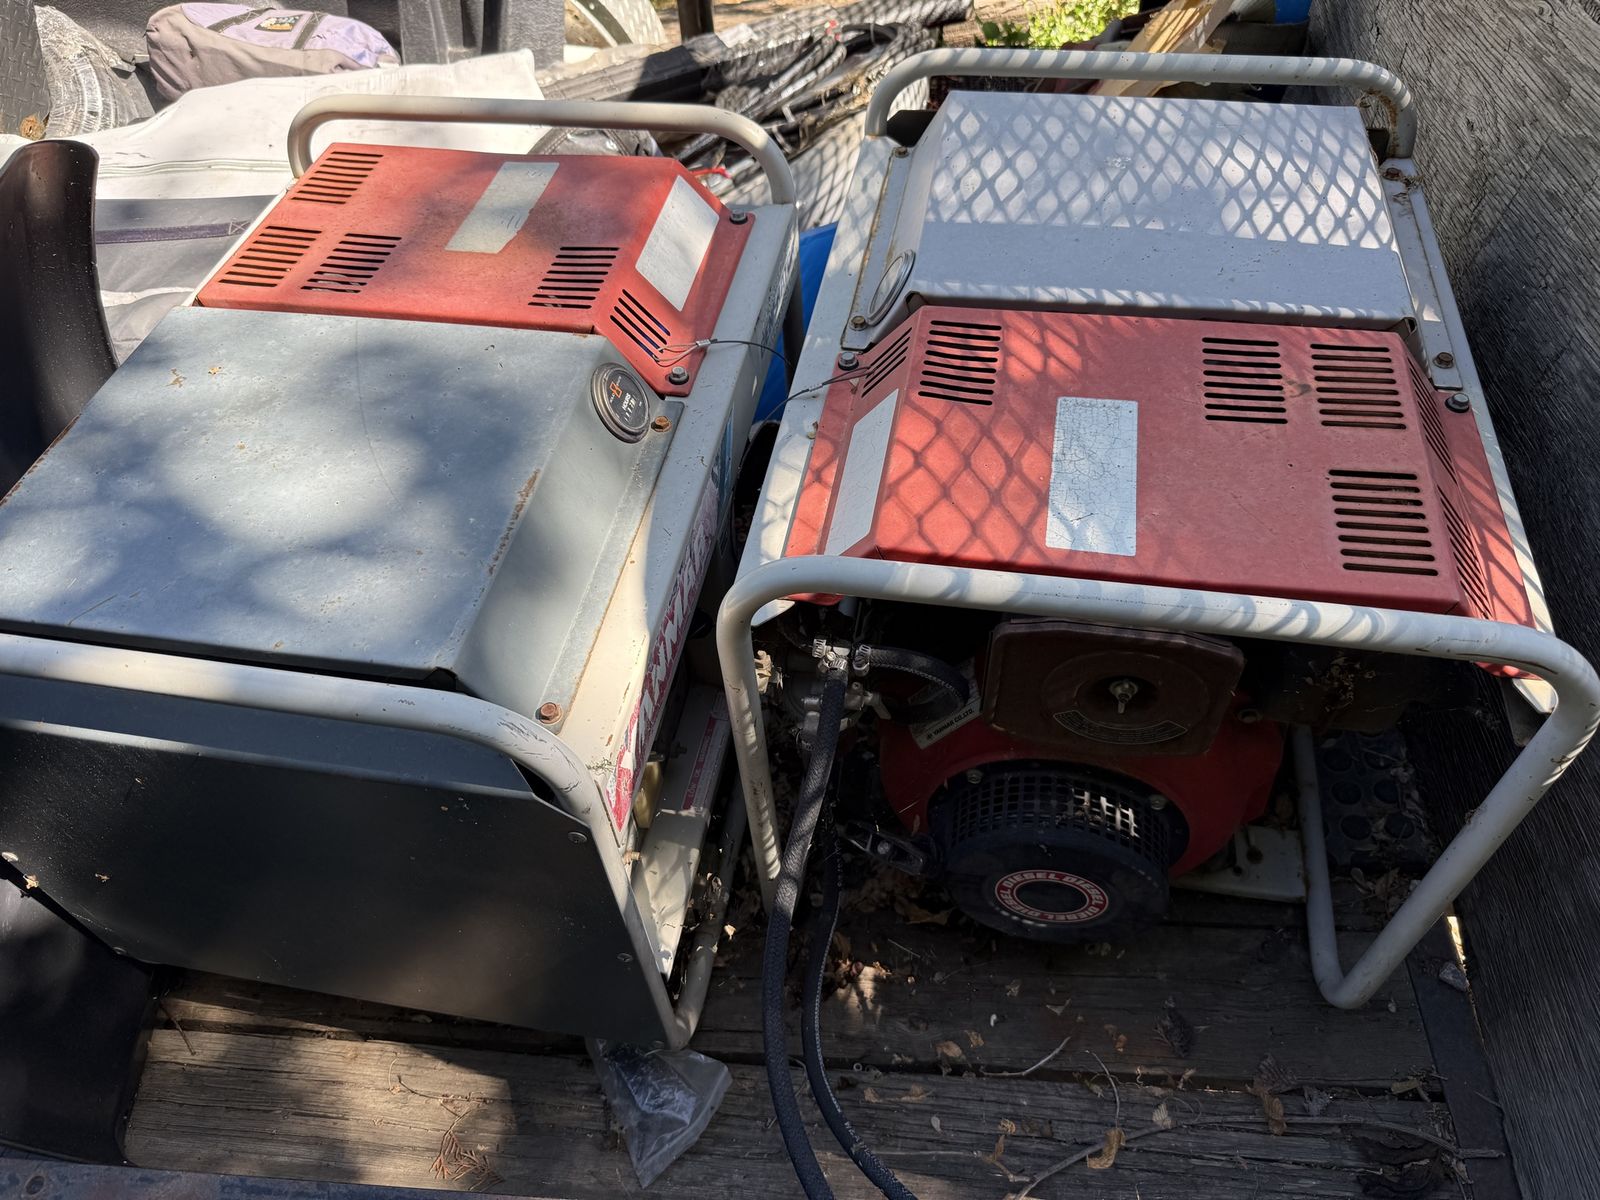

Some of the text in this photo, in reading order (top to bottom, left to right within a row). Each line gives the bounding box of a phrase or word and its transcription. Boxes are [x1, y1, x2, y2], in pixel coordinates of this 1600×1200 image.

[619, 516, 706, 774] YANMAR
[933, 720, 954, 735] YANMAR
[1002, 872, 1061, 889] DIESEL
[1062, 876, 1105, 905] DIESEL
[1000, 889, 1040, 917] DIESEL
[1044, 906, 1101, 920] DIESEL
